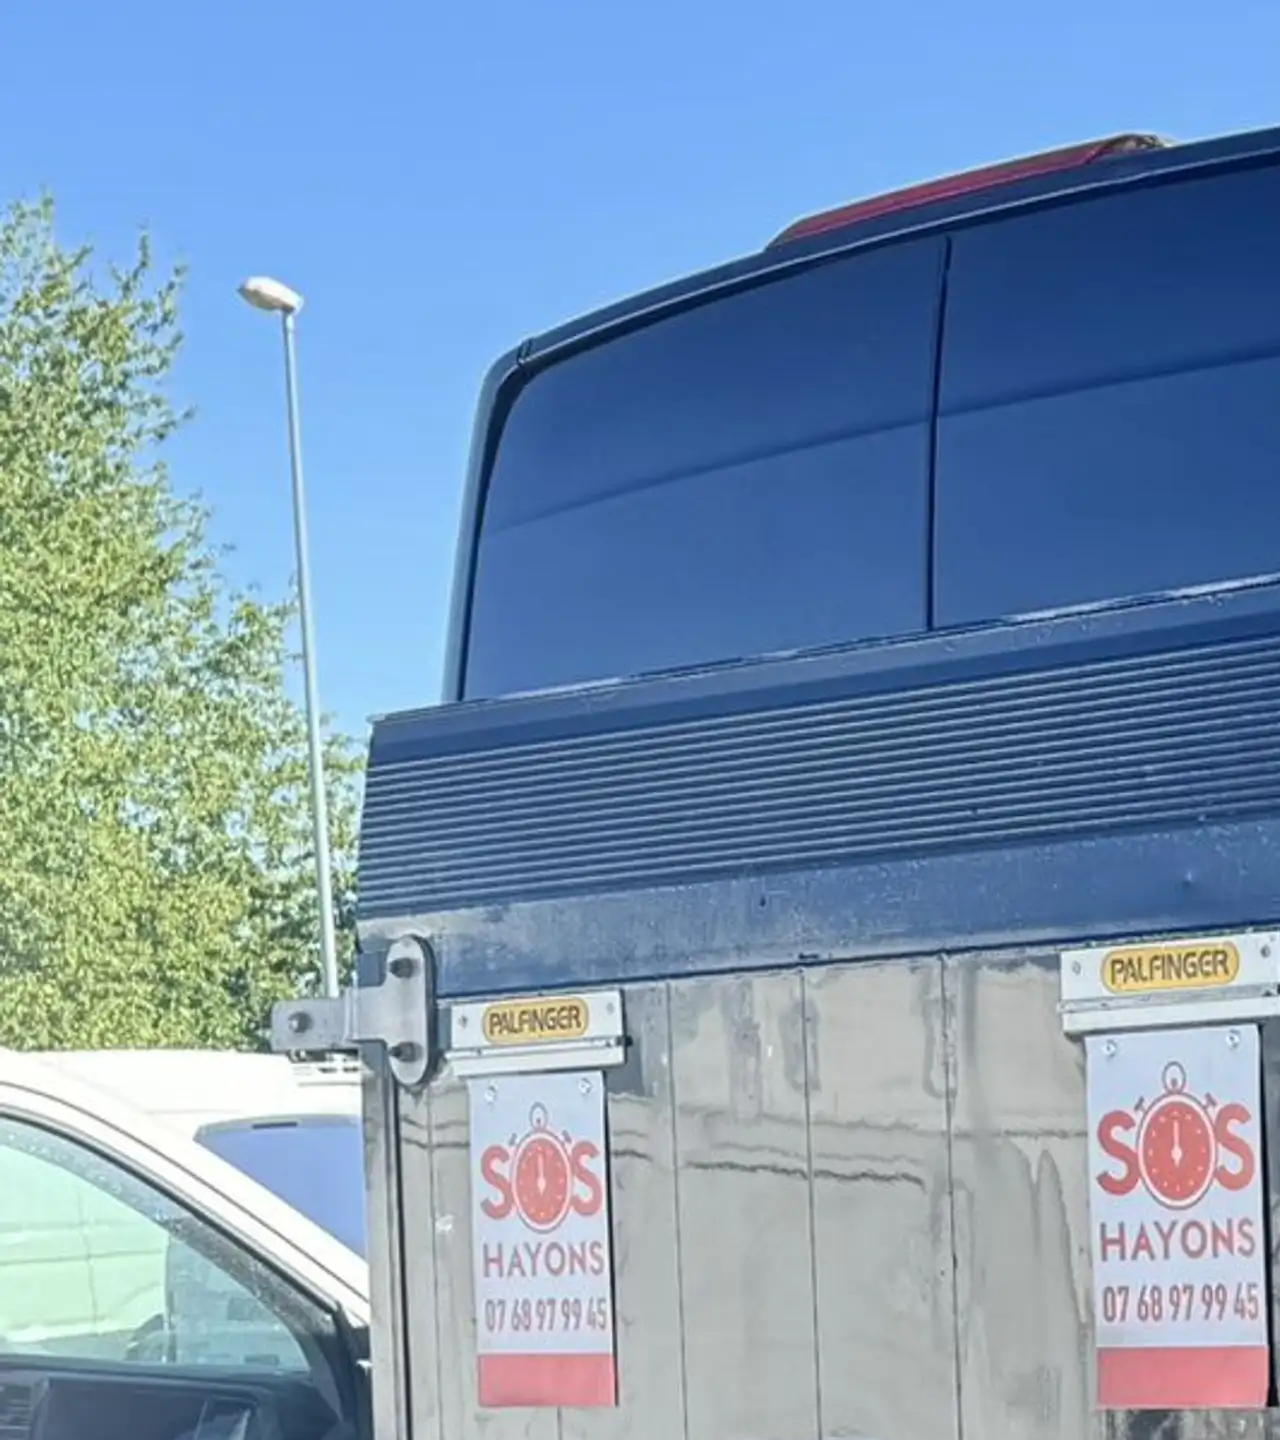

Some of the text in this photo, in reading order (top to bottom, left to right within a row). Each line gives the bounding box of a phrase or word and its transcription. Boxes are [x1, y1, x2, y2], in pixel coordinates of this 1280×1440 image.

[1111, 949, 1231, 986] PALFINGER
[489, 1004, 582, 1036] PALFINGER
[1096, 1091, 1255, 1210] SOS
[480, 1130, 604, 1234] SOS
[482, 1240, 605, 1278] HAYONS
[1100, 1217, 1256, 1263] HAYONS
[484, 1297, 608, 1333] 07 68 97 99 45
[1103, 1281, 1260, 1323] 07 68 97 99 45
